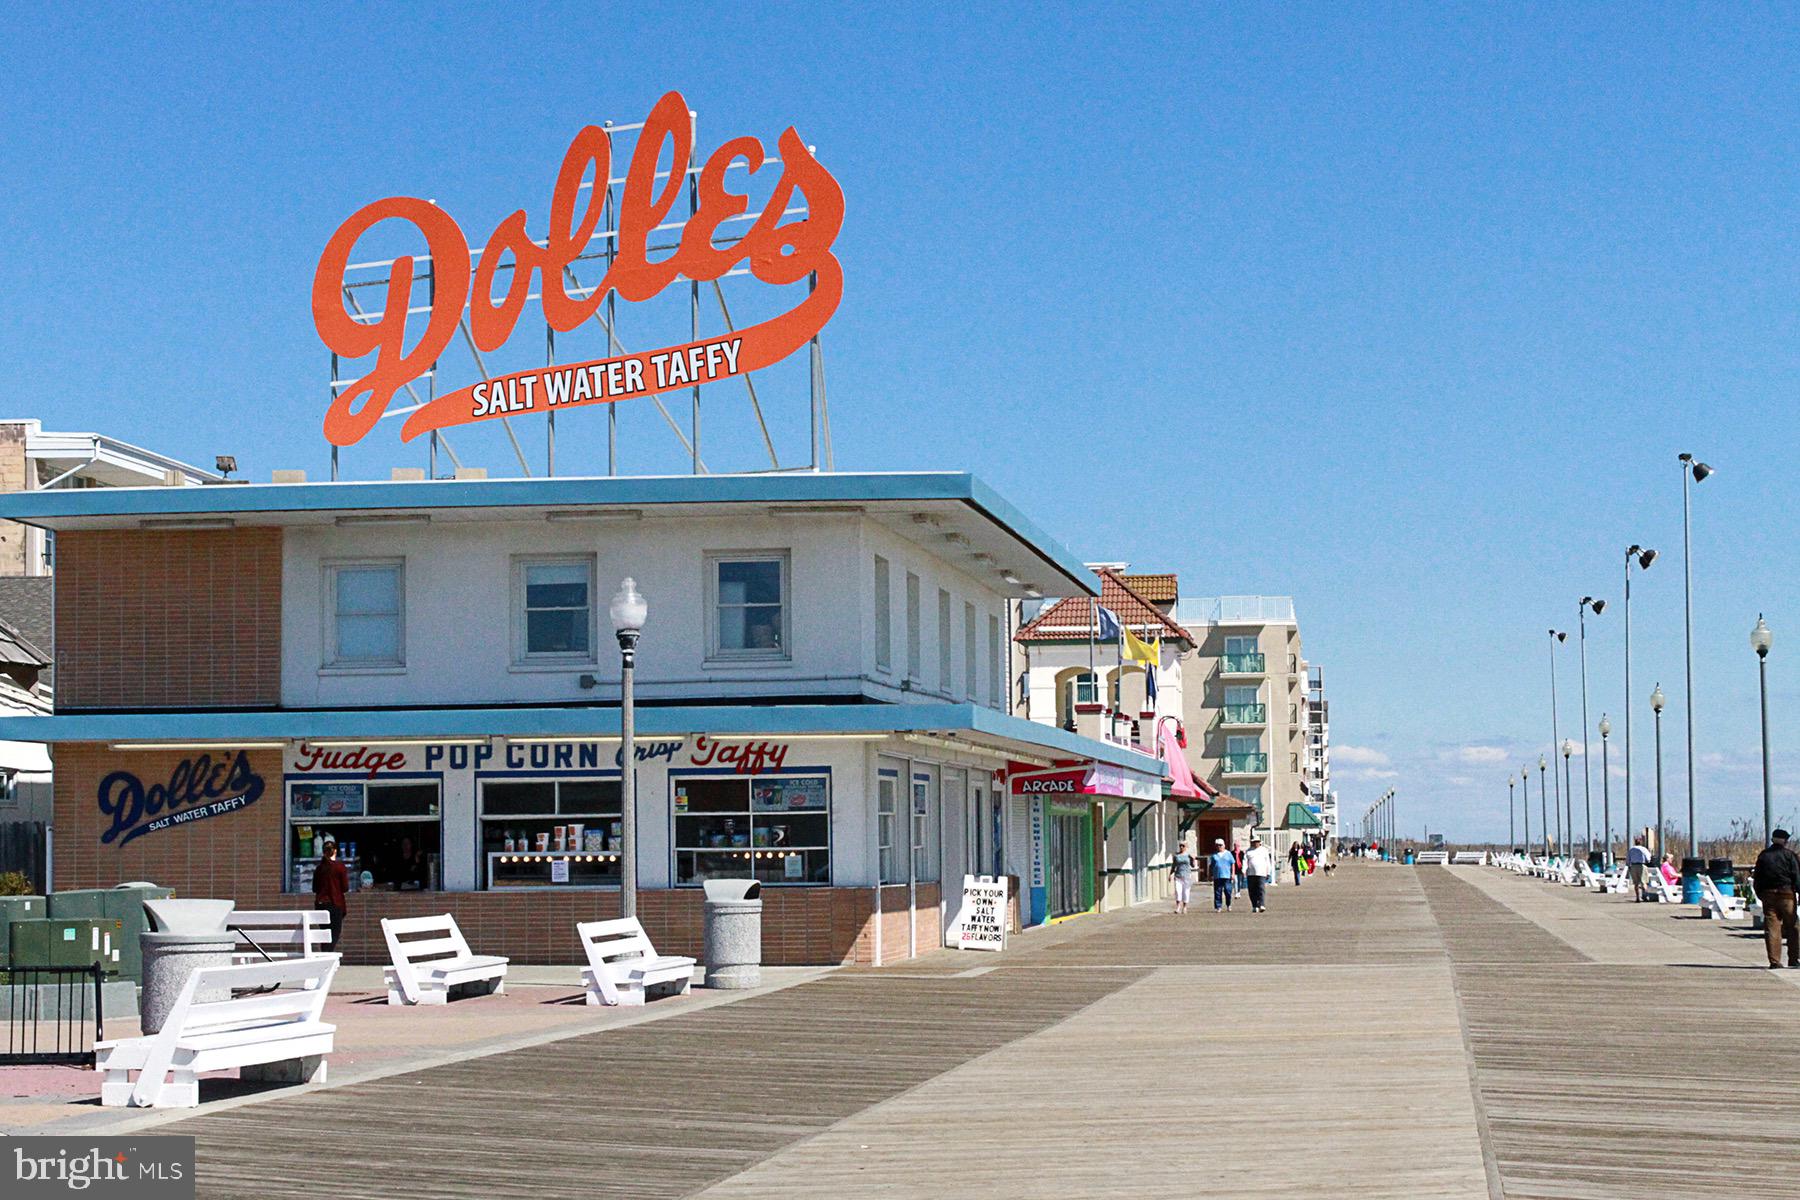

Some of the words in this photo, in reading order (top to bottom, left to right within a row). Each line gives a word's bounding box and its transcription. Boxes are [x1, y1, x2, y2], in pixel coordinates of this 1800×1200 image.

[472, 375, 539, 417] SALT
[543, 359, 645, 406] WATER
[650, 338, 743, 388] TAFFY
[294, 743, 407, 780] Fudge
[426, 744, 493, 770] POP
[506, 744, 598, 769] CORN
[691, 737, 789, 776] Taffy
[1022, 779, 1075, 793] ARCADE
[98, 750, 265, 845] Dolle's
[148, 818, 170, 832] SALT
[173, 808, 209, 823] WATER
[210, 795, 247, 814] TAFFY
[964, 888, 981, 897] PICK
[984, 889, 1003, 897] YOUR
[971, 915, 995, 924] WATER
[976, 907, 994, 915] SALT
[961, 924, 983, 932] TAFFY
[971, 933, 1002, 942] FLAVORS
